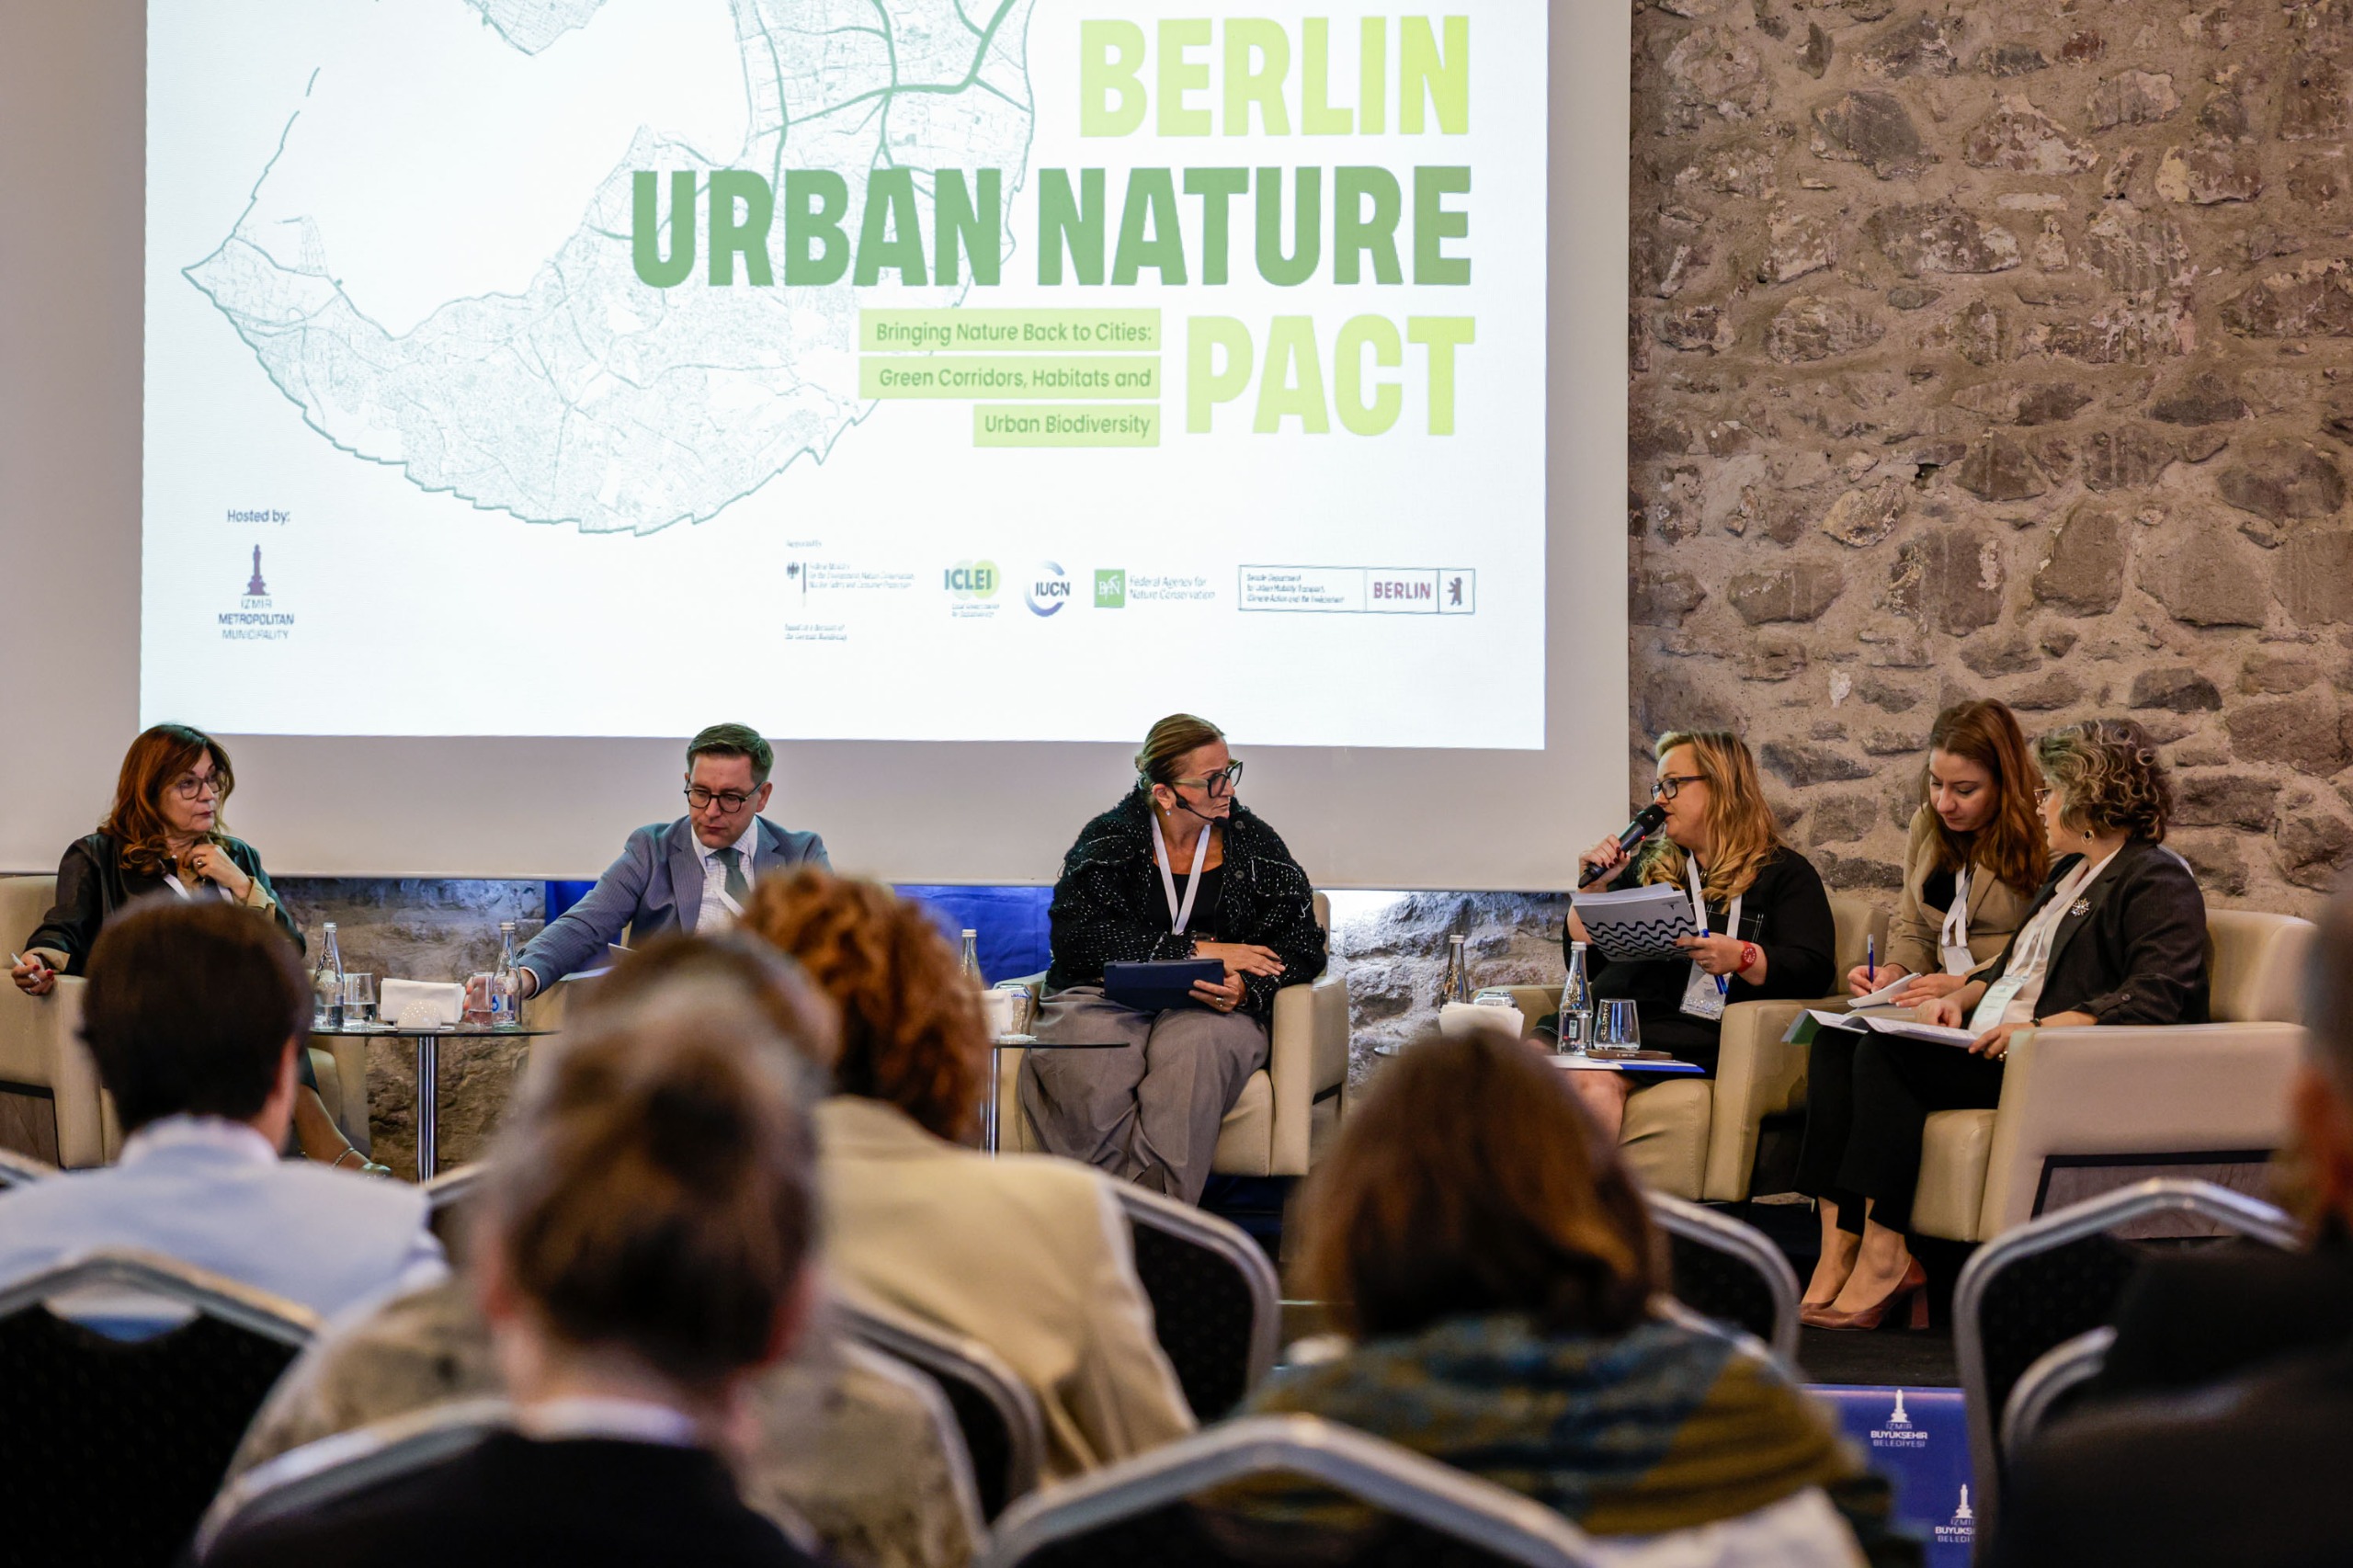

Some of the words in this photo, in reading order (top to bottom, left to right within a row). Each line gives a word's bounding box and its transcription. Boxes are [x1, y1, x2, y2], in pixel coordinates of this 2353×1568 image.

[1080, 16, 1471, 137] BERLIN
[631, 167, 1003, 288] URBAN
[1038, 165, 1472, 287] NATURE
[876, 322, 951, 347] Bringing
[956, 323, 1018, 341] Nature
[1023, 323, 1068, 341] Back
[1073, 324, 1091, 341] to
[1095, 323, 1152, 341] Cities:
[879, 368, 934, 387] Green
[938, 368, 1028, 388] Corridors,
[1032, 369, 1110, 387] Habitats
[1114, 369, 1152, 387] and
[1186, 314, 1475, 436] PACT
[984, 415, 1040, 433] Urban
[1045, 415, 1150, 438] Biodiversity
[227, 509, 269, 523] Hosted
[273, 509, 290, 526] by:
[944, 569, 993, 590] ICLEI
[1130, 575, 1160, 586] Federal
[1162, 576, 1192, 589] Agency
[1194, 575, 1207, 586] for
[1035, 582, 1071, 597] IUCN
[1130, 589, 1157, 599] Nature
[1159, 589, 1216, 600] Conservation
[1373, 581, 1431, 600] BERLIN
[219, 613, 294, 625] METROPOLITAN
[222, 629, 289, 640] MUNICIPALITY
